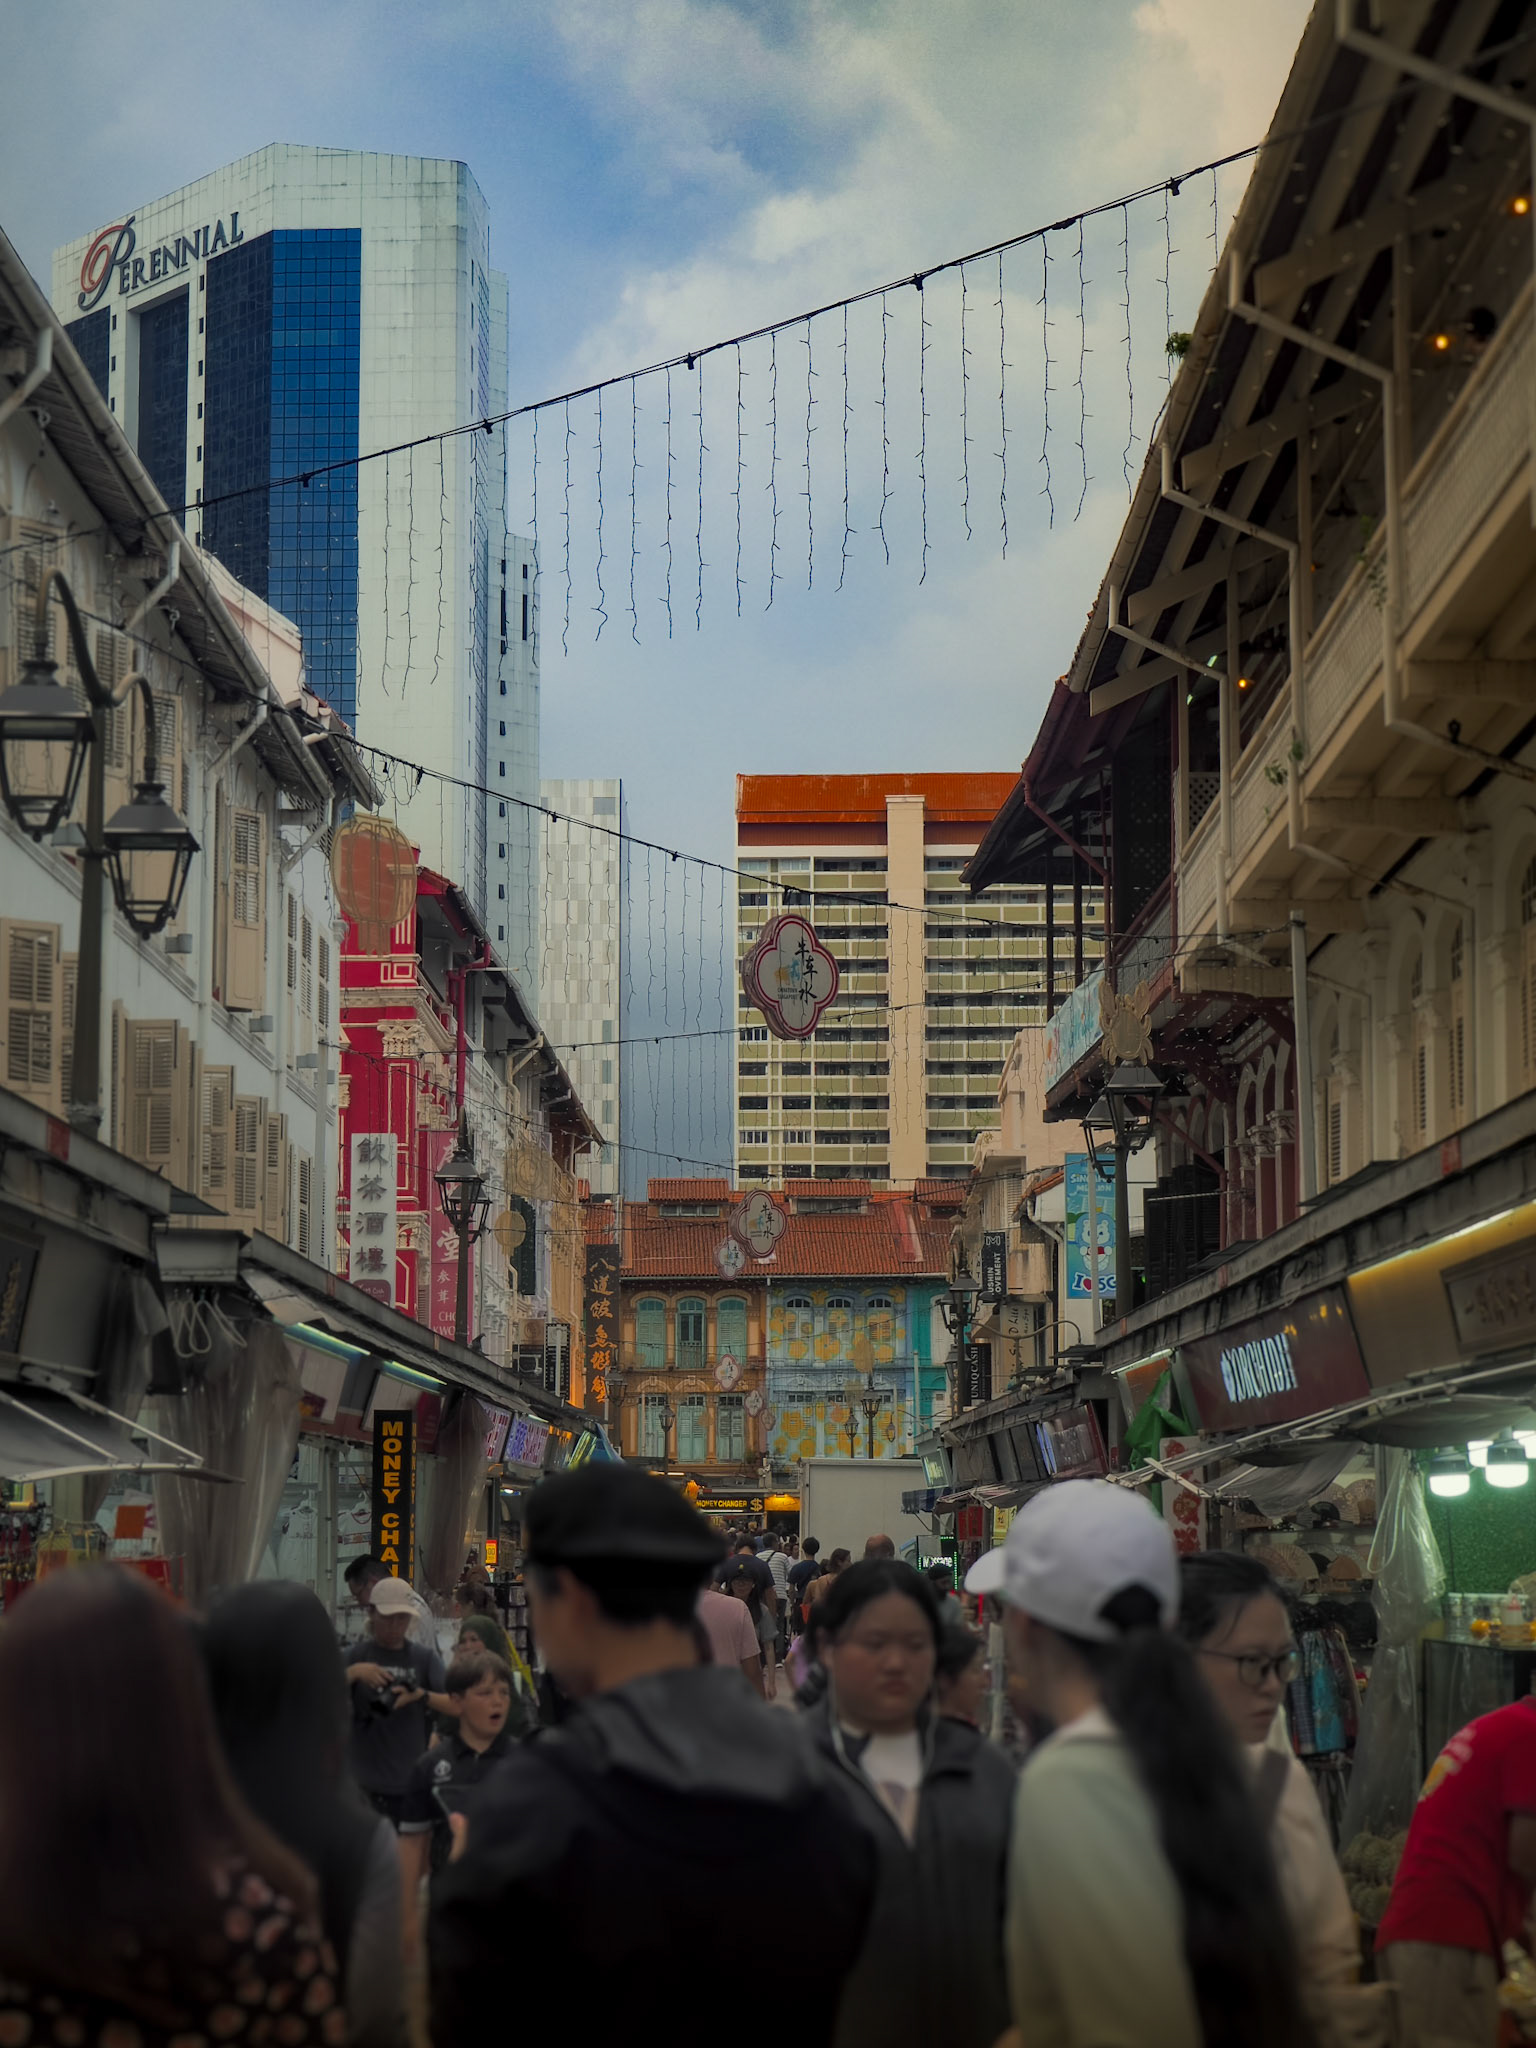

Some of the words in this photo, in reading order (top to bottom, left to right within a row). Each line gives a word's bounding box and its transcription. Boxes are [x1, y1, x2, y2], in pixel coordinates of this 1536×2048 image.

[78, 212, 244, 311] PERENNIAL
[355, 1137, 389, 1274] 飲茶酒樓
[970, 1345, 980, 1399] UNIQCASH
[381, 1420, 405, 1504] MONEY
[718, 1499, 748, 1508] CHANGER
